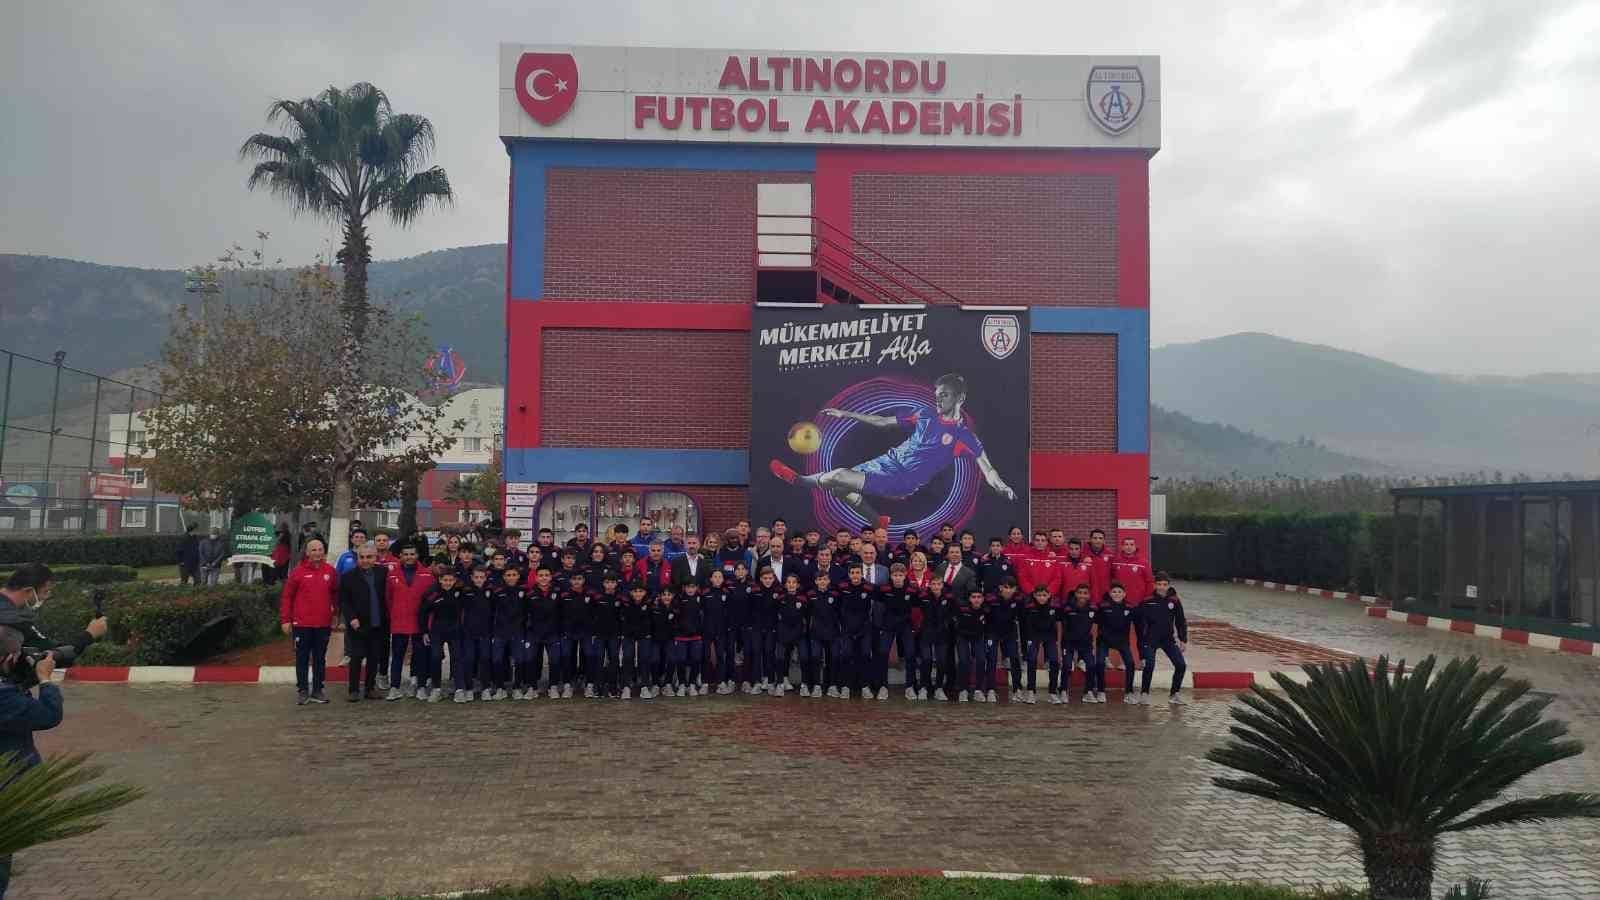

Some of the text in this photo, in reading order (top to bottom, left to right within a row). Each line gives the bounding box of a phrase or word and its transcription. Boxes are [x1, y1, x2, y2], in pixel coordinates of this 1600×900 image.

[718, 55, 947, 93] ALTINORDU
[634, 93, 1023, 136] FUTBOL AKADEMİSİ
[759, 313, 928, 345] MÜKEMMELİYET
[779, 336, 872, 365] MERKEZİ
[877, 334, 932, 366] Alfa
